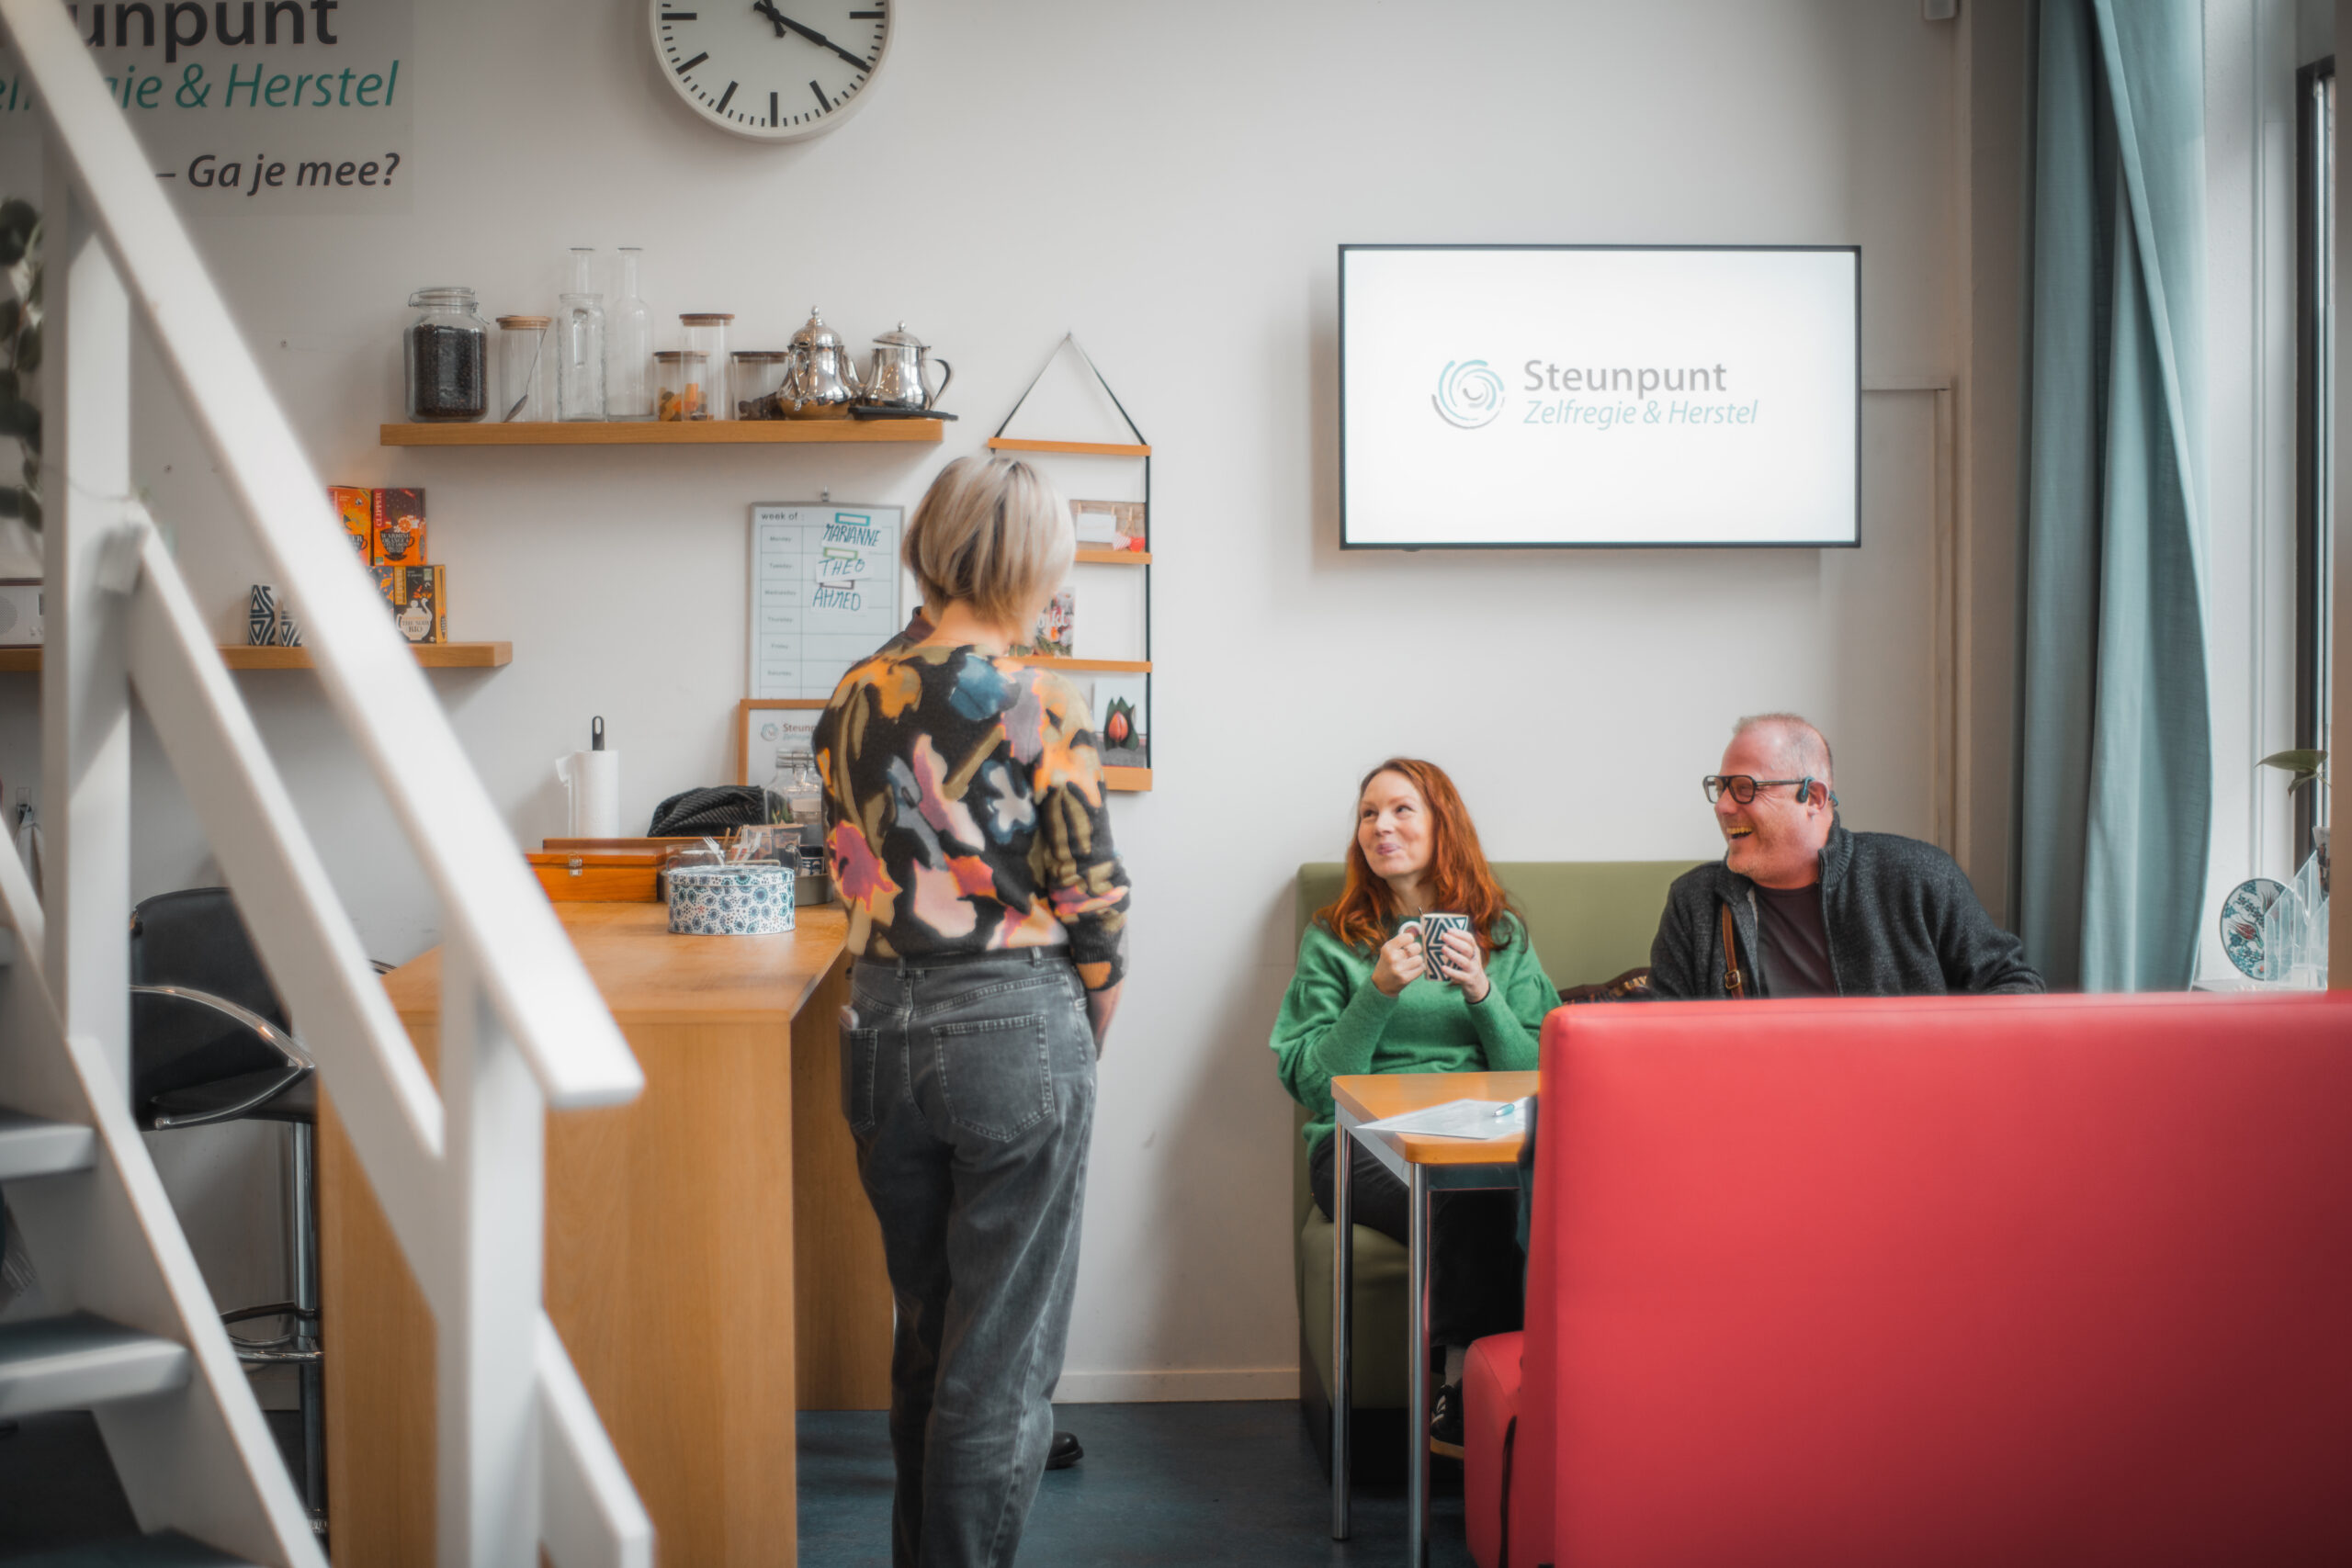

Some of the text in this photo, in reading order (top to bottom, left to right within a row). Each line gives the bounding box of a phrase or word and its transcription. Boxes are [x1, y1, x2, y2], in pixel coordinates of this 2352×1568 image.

[66, 0, 338, 62] unpunt
[174, 63, 211, 108] &
[224, 60, 400, 107] Herstel
[187, 154, 242, 187] Ga
[246, 153, 286, 197] je
[296, 152, 401, 186] mee?
[1523, 359, 1727, 400] Steunpunt
[1522, 399, 1758, 431] Zelfregie & Herstel
[761, 512, 798, 521] week of
[822, 523, 881, 547] MARIANNE
[818, 558, 865, 577] THEO
[812, 587, 861, 612] AHMED
[783, 722, 816, 735] Steunp
